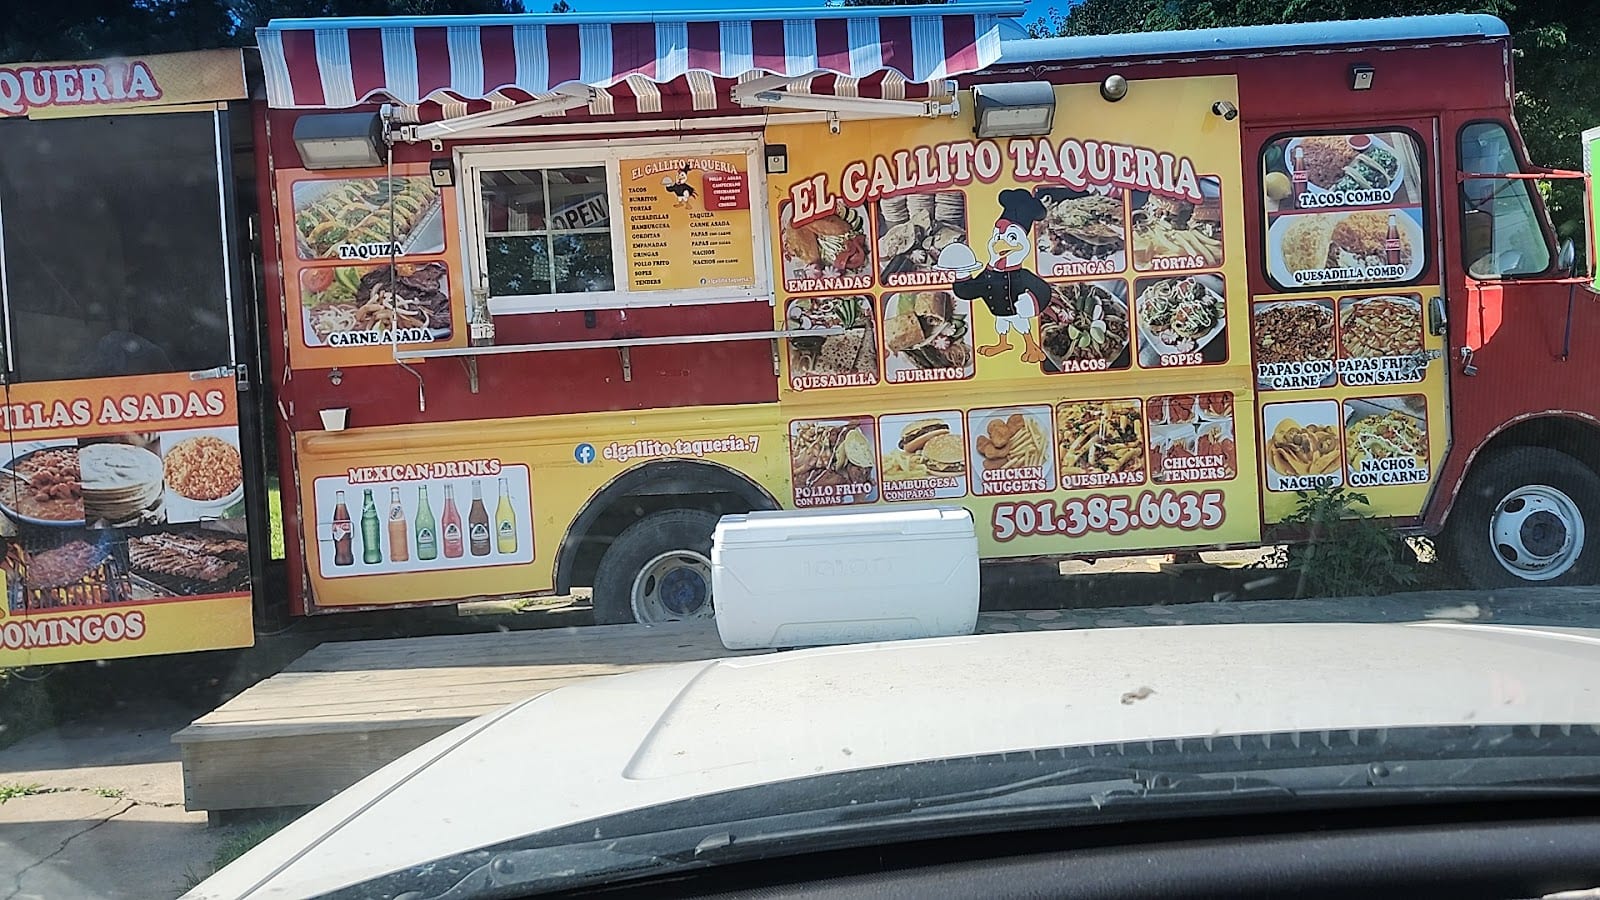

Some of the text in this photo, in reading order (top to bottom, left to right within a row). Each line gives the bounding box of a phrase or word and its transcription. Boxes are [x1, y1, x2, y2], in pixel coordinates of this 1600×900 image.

[631, 159, 738, 180] EL GALLITO TAQUERIA
[789, 138, 1203, 227] EL GALLITO TAQUERIA
[1300, 189, 1392, 207] TACOS COMBO
[553, 199, 607, 230] OPEN
[630, 214, 669, 222] QUESADILLAS
[690, 221, 710, 229] CARNE
[339, 243, 403, 258] TAQUIZA
[632, 241, 668, 249] EMPANADAS
[1053, 261, 1115, 277] GRINGAS
[1151, 256, 1205, 271] TORTAS
[888, 271, 957, 286] GORDITAS
[1294, 265, 1405, 283] QUESADILLA COMBO
[787, 275, 872, 293] EMPANADAS
[329, 332, 379, 345] CARNE
[1062, 359, 1106, 372] TACOS
[1160, 353, 1203, 366] SOPES
[1337, 358, 1378, 372] PAPAS
[896, 367, 964, 383] BURRITOS
[1259, 360, 1332, 377] PAPAS CON
[1346, 368, 1420, 384] CON SALSA
[792, 373, 877, 391] QUESADILLA
[1273, 375, 1319, 388] CARNE
[0, 390, 225, 429] ILLAS ASADAS
[602, 433, 760, 462] elgallito.taqueria.7
[1163, 454, 1224, 470] CHICKEN
[1361, 458, 1415, 472] NACHOS
[349, 459, 501, 484] MEXICAN DRINKS
[982, 467, 1043, 481] CHICKEN
[1061, 471, 1145, 488] QUESIPAPAS
[1163, 467, 1225, 482] TENDERS
[1351, 469, 1427, 486] CON CARNE
[795, 482, 872, 499] POLLO FRITO
[882, 477, 958, 491] HAMBURGESA
[982, 480, 1047, 494] NUGGETS
[795, 496, 841, 506] CON PAPAS
[884, 489, 936, 500] CON PAPAS
[994, 491, 1223, 540] 501.385.6635
[0, 612, 144, 649] OMINGOS
